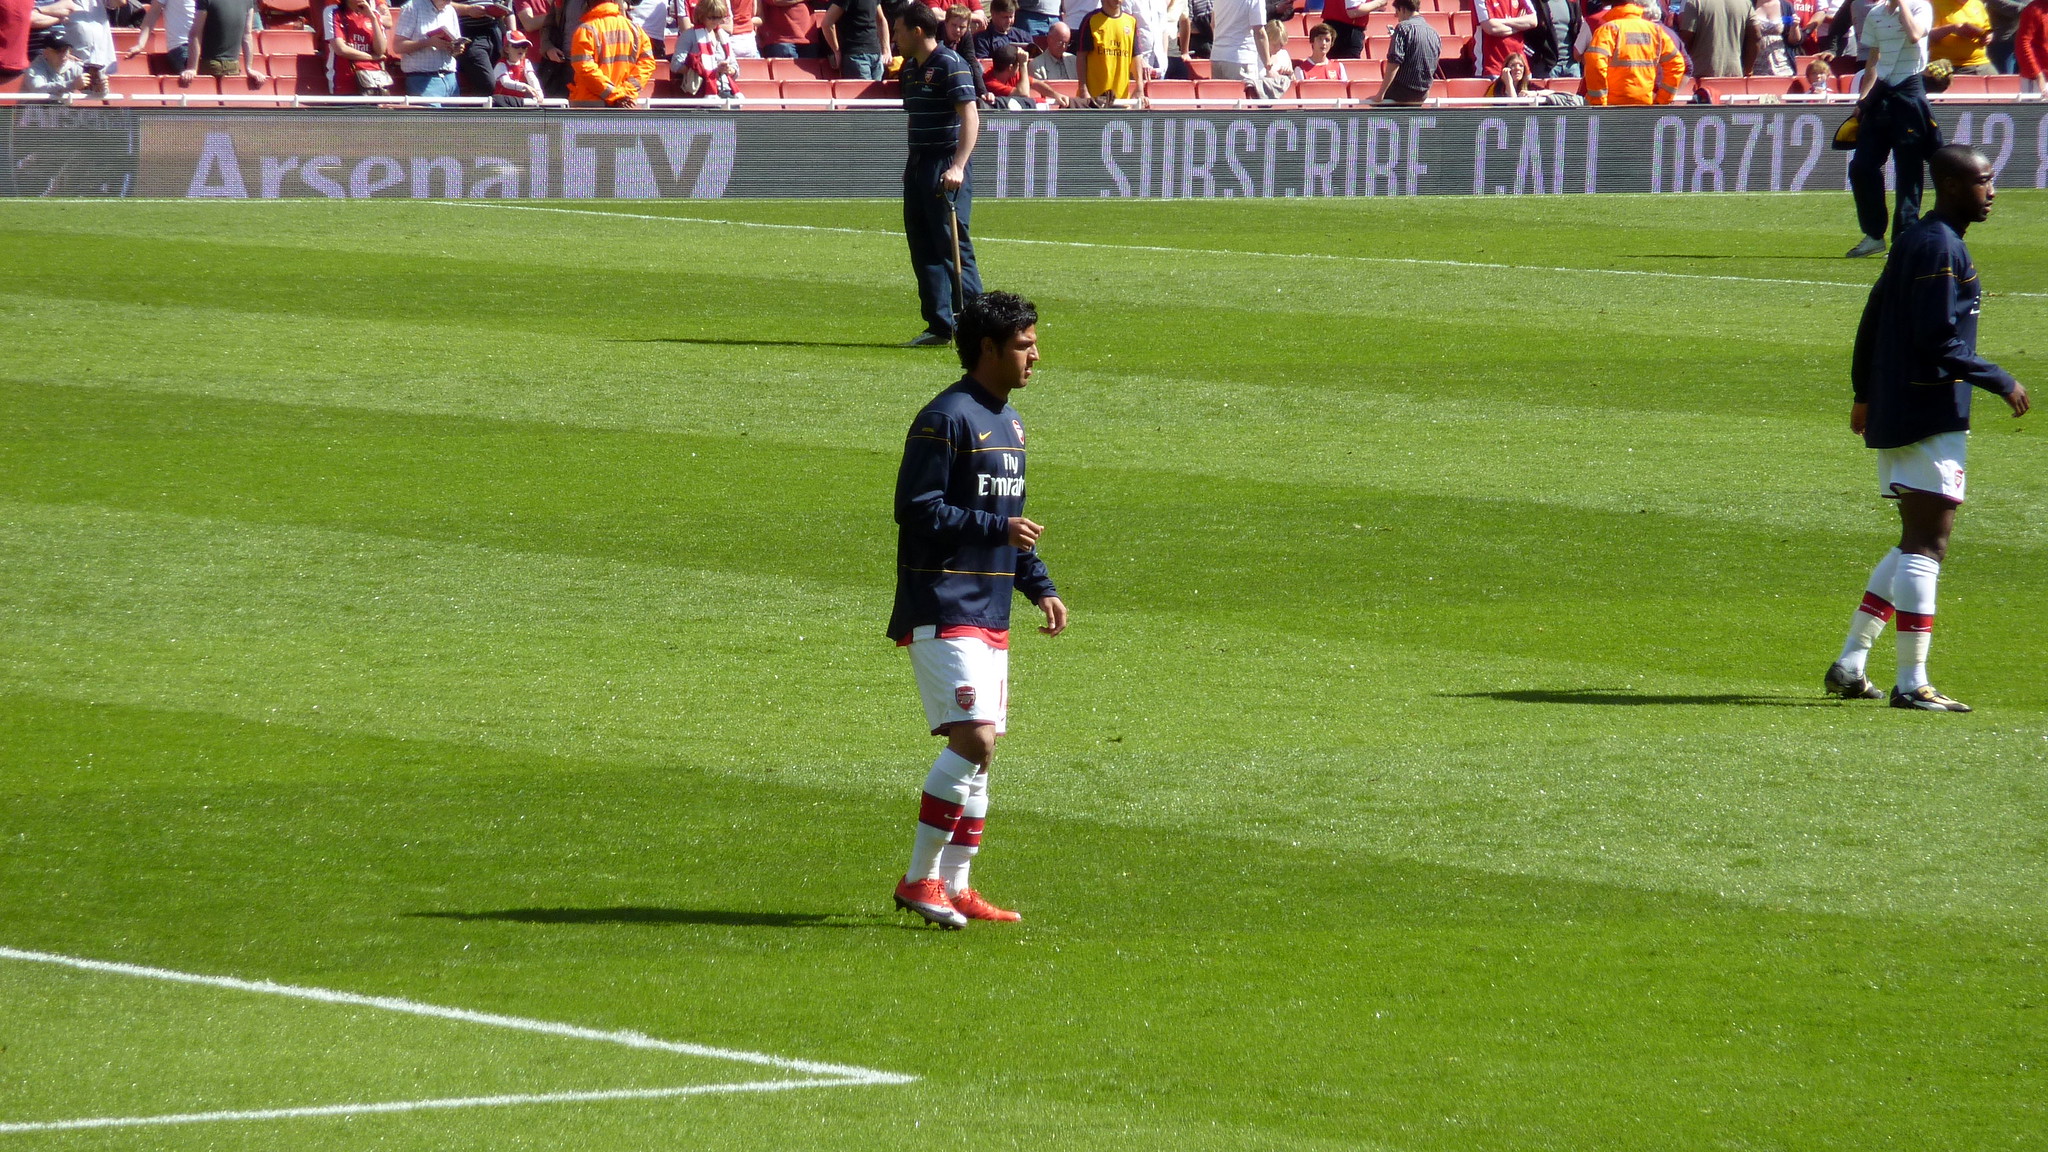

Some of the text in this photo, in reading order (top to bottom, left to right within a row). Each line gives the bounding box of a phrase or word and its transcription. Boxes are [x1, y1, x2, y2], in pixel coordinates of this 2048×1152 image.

[187, 132, 713, 199] Arsenal TV
[986, 118, 1059, 198] TO
[1099, 116, 1438, 198] SUBSCRIBE
[977, 473, 1025, 497] Emirat
[1002, 452, 1019, 474] Fly
